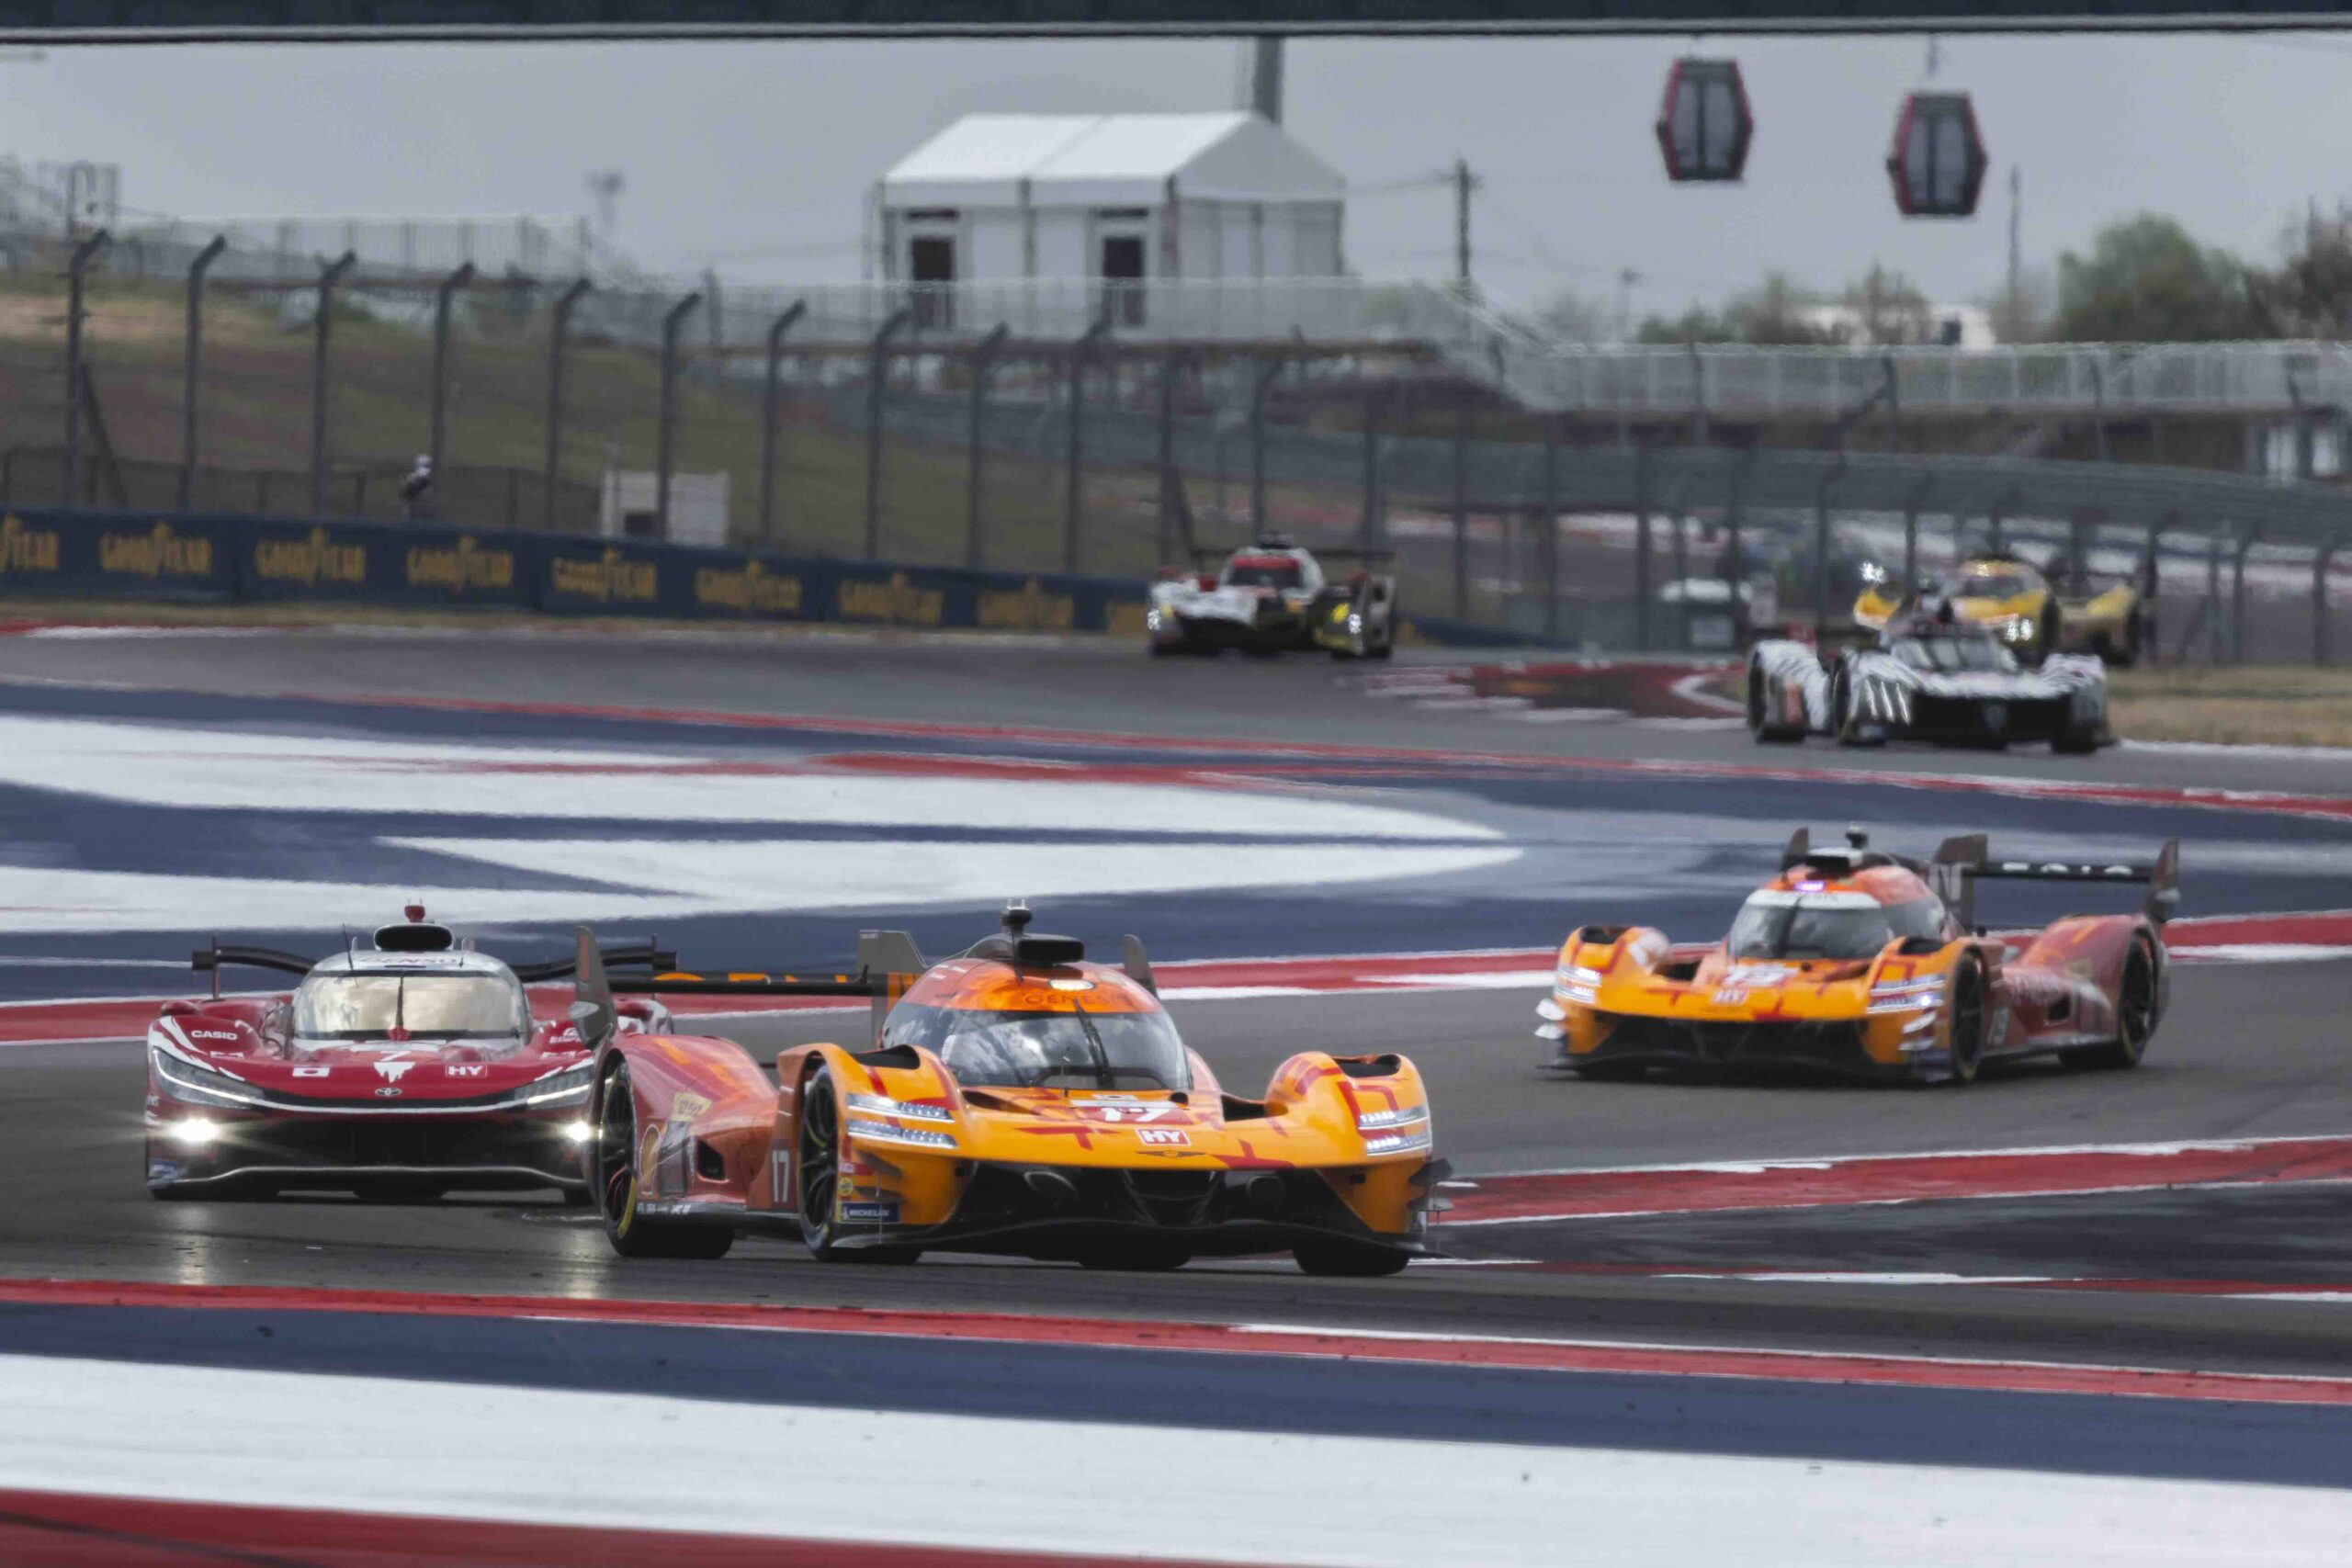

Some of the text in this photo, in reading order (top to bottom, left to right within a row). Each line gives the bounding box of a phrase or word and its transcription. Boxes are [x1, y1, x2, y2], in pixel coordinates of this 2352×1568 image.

[191, 1030, 238, 1040] CASIO
[447, 1065, 483, 1076] HY
[1101, 1107, 1170, 1122] 17
[1140, 1129, 1182, 1142] HY
[773, 1150, 789, 1202] 17
